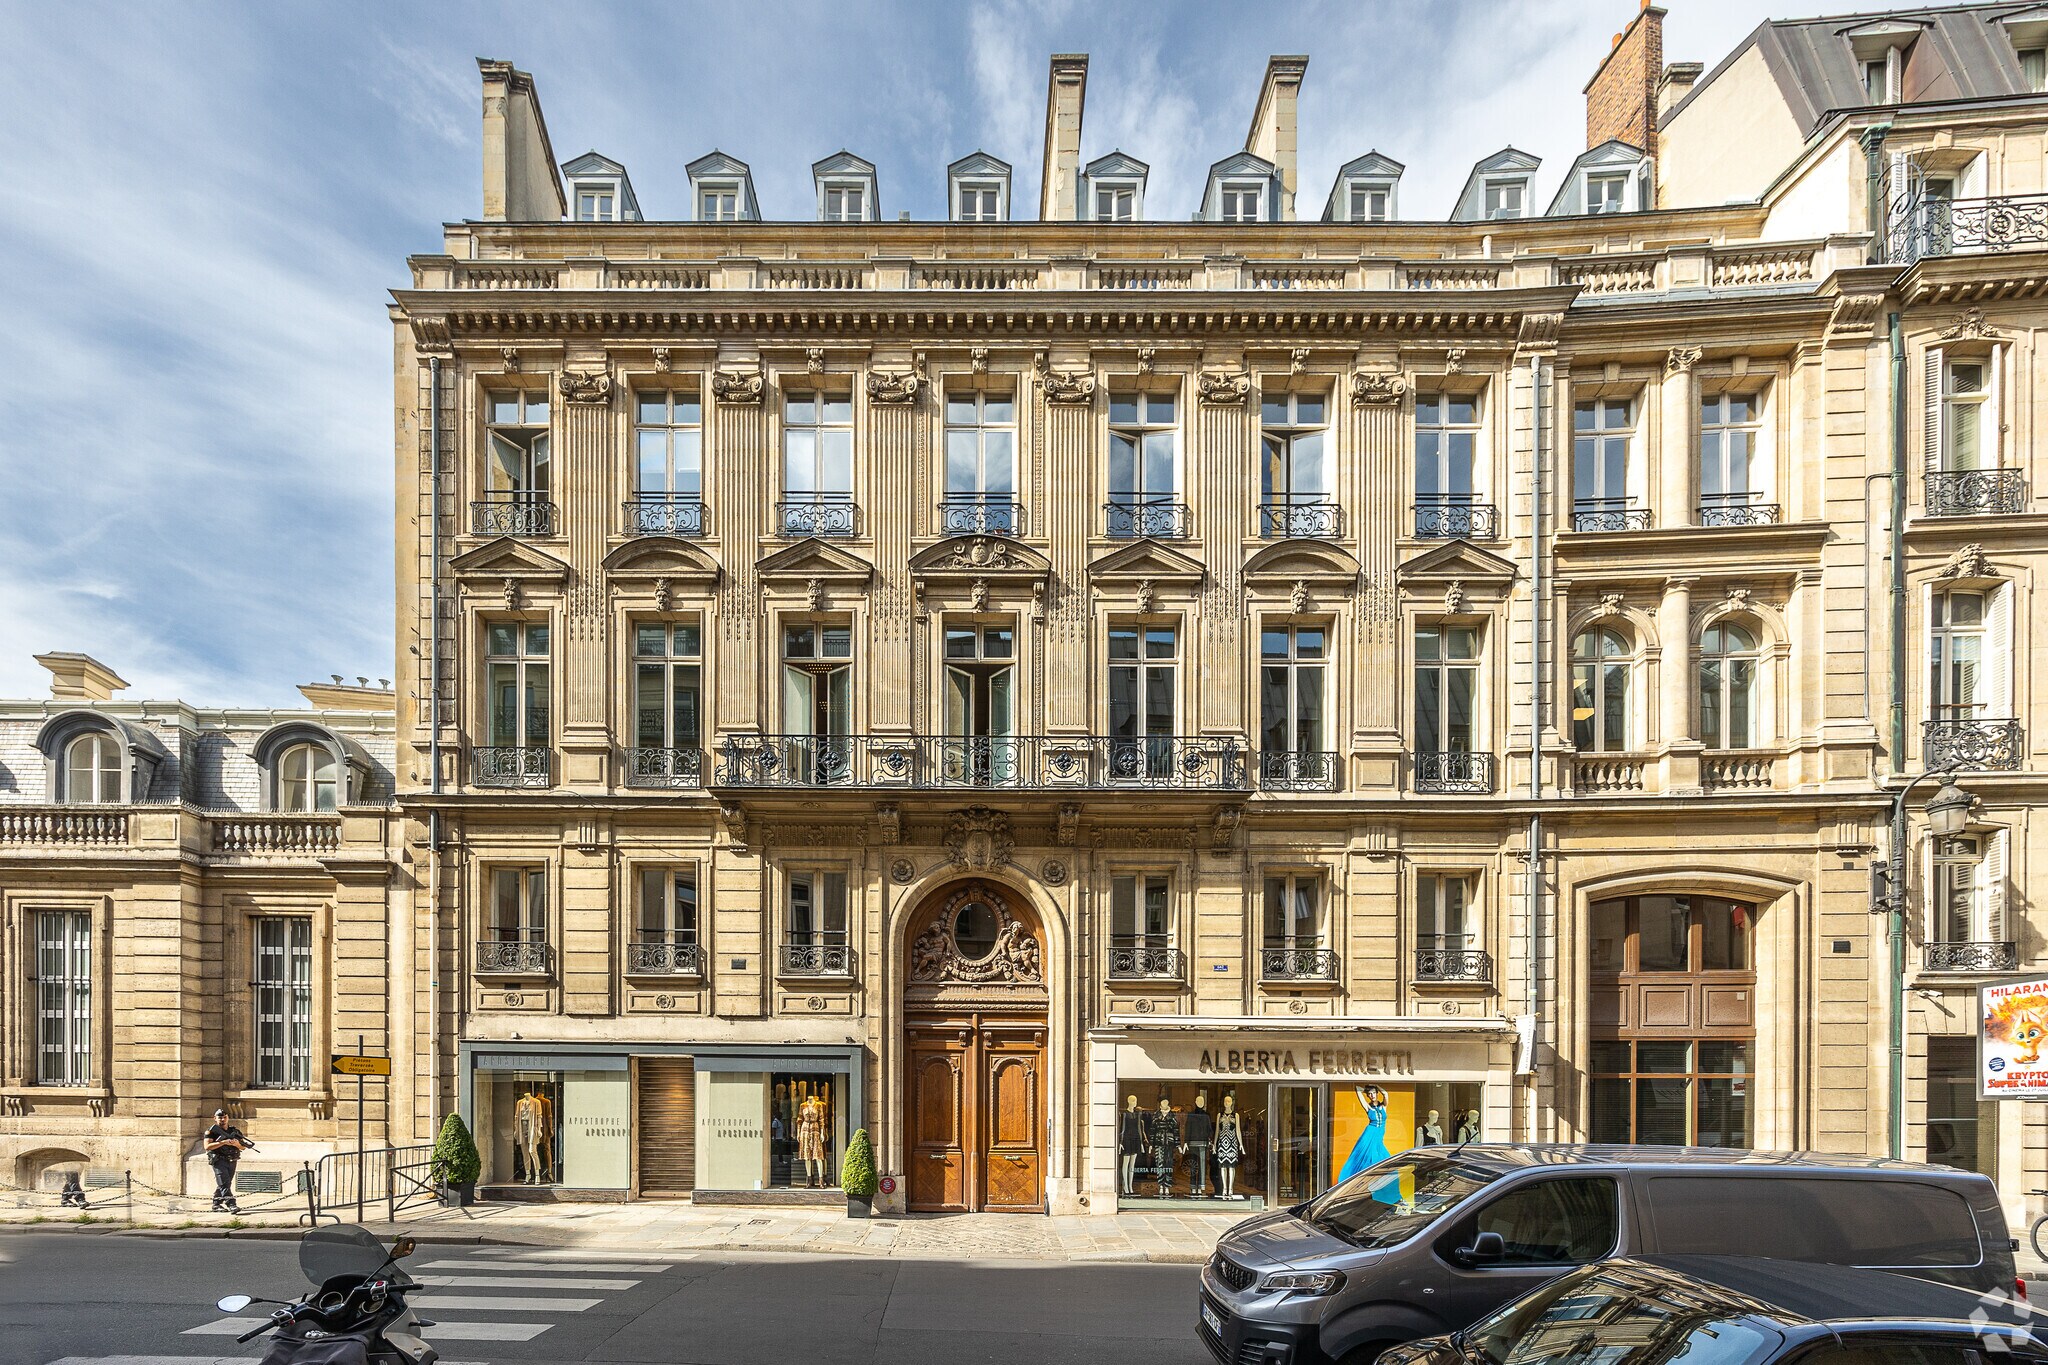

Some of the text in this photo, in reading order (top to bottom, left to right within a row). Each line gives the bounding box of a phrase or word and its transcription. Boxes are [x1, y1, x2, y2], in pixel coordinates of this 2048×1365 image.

[1198, 1050, 1413, 1075] ALBERTA FERRETTI
[568, 1117, 620, 1126] APOSTROPHE
[701, 1118, 752, 1127] APOSTROPHE
